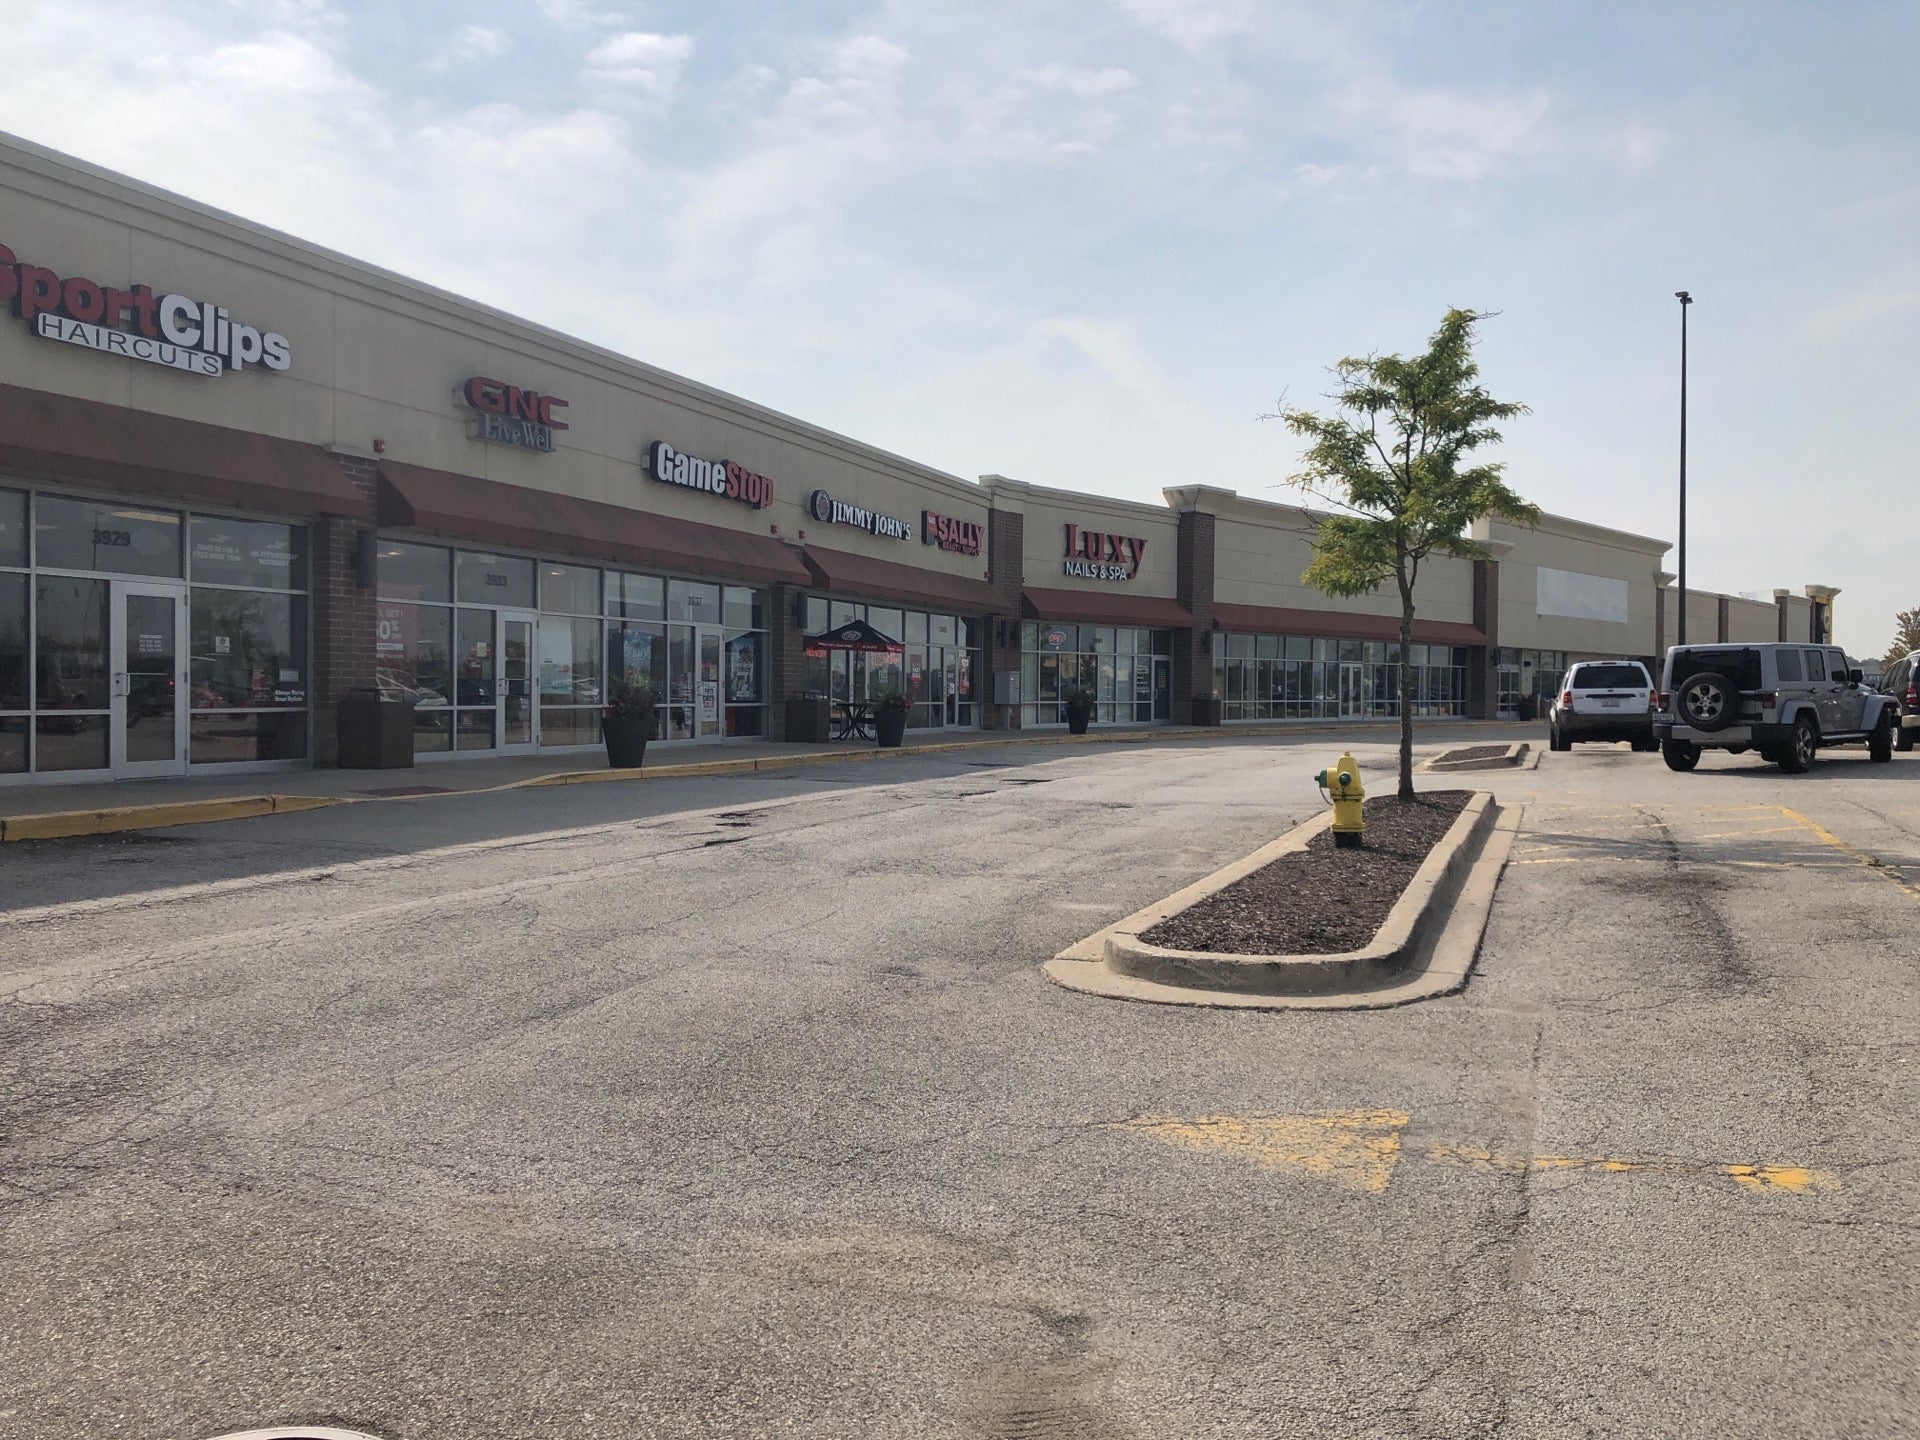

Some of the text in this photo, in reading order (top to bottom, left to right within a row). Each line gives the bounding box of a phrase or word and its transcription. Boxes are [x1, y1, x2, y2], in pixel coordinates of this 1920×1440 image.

[42, 315, 219, 374] HAIRCUTS
[465, 377, 569, 430] GNC
[657, 442, 774, 509] GameStop
[832, 500, 911, 540] JIMMY JOHN'S
[938, 515, 985, 549] SALLY
[1066, 561, 1128, 580] NAILS & SPA
